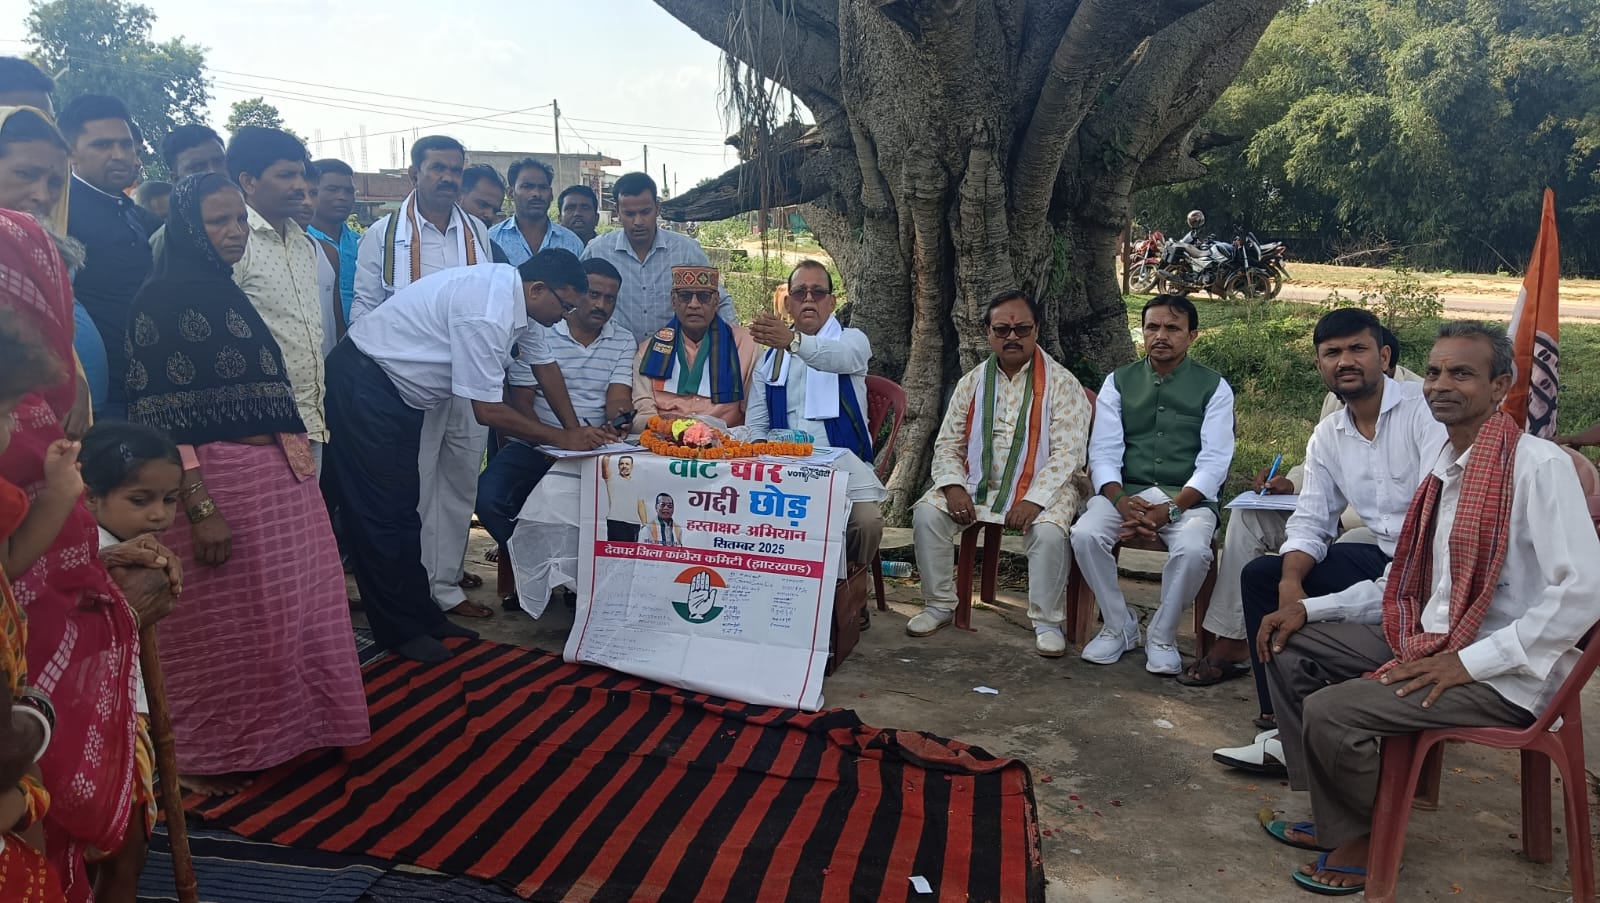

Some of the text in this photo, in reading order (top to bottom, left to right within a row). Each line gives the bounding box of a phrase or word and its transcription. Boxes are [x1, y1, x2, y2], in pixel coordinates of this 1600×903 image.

[688, 484, 811, 527] गद्दी छोड़
[686, 519, 806, 542] हस्ताक्षर अभियान
[604, 543, 812, 576] देवघर जिला कांग्रेस कमिटी (झारखण्ड)
[713, 536, 785, 555] सितम्बर 2025
